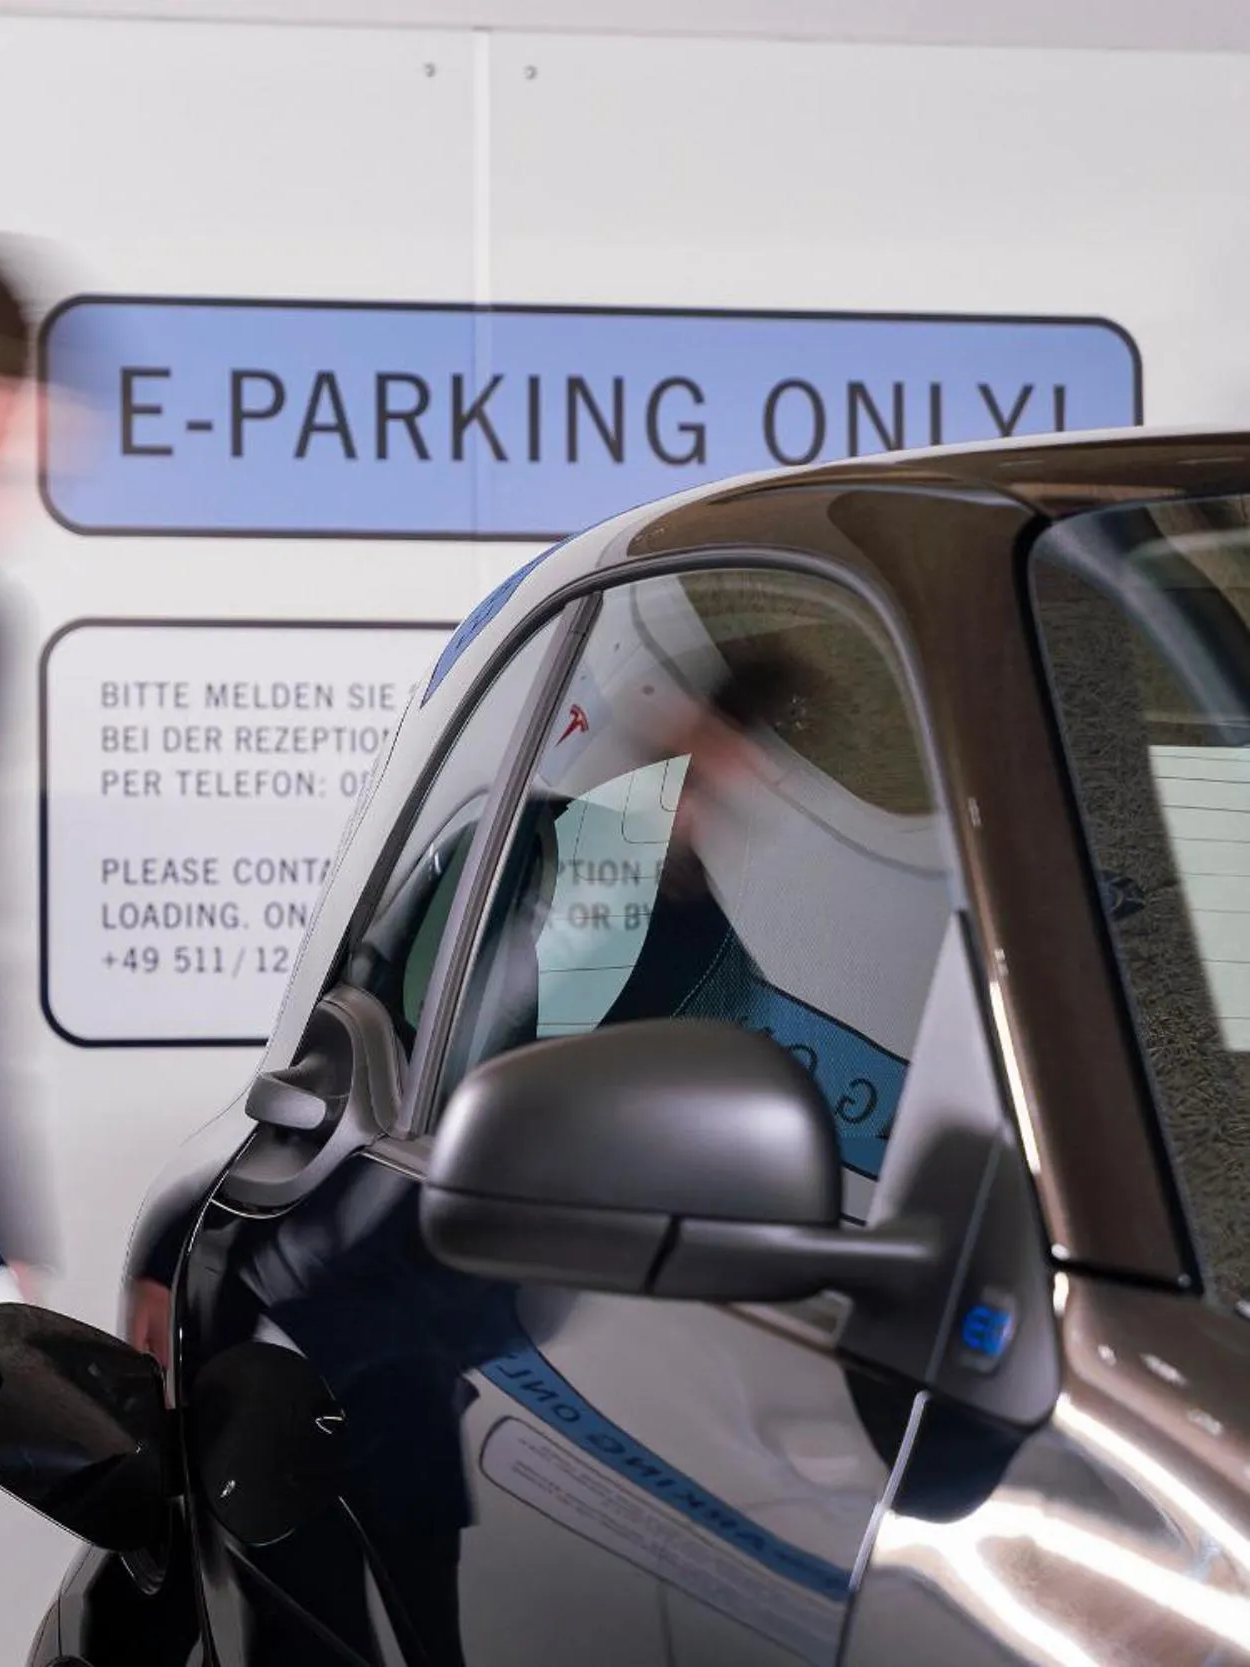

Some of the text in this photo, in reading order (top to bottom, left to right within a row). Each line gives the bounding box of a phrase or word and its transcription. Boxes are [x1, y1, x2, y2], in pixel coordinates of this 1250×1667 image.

[120, 366, 707, 466] E-PARKING
[100, 681, 190, 709] BITTE
[205, 683, 336, 710] MELDEN
[347, 684, 397, 712] SIE
[100, 726, 150, 753] BEI
[163, 726, 223, 754] DER
[100, 770, 163, 797] PER
[176, 770, 328, 798] TELEFON:
[101, 858, 221, 885] PLEASE
[102, 902, 250, 930] LOADING.
[101, 946, 160, 973] +49
